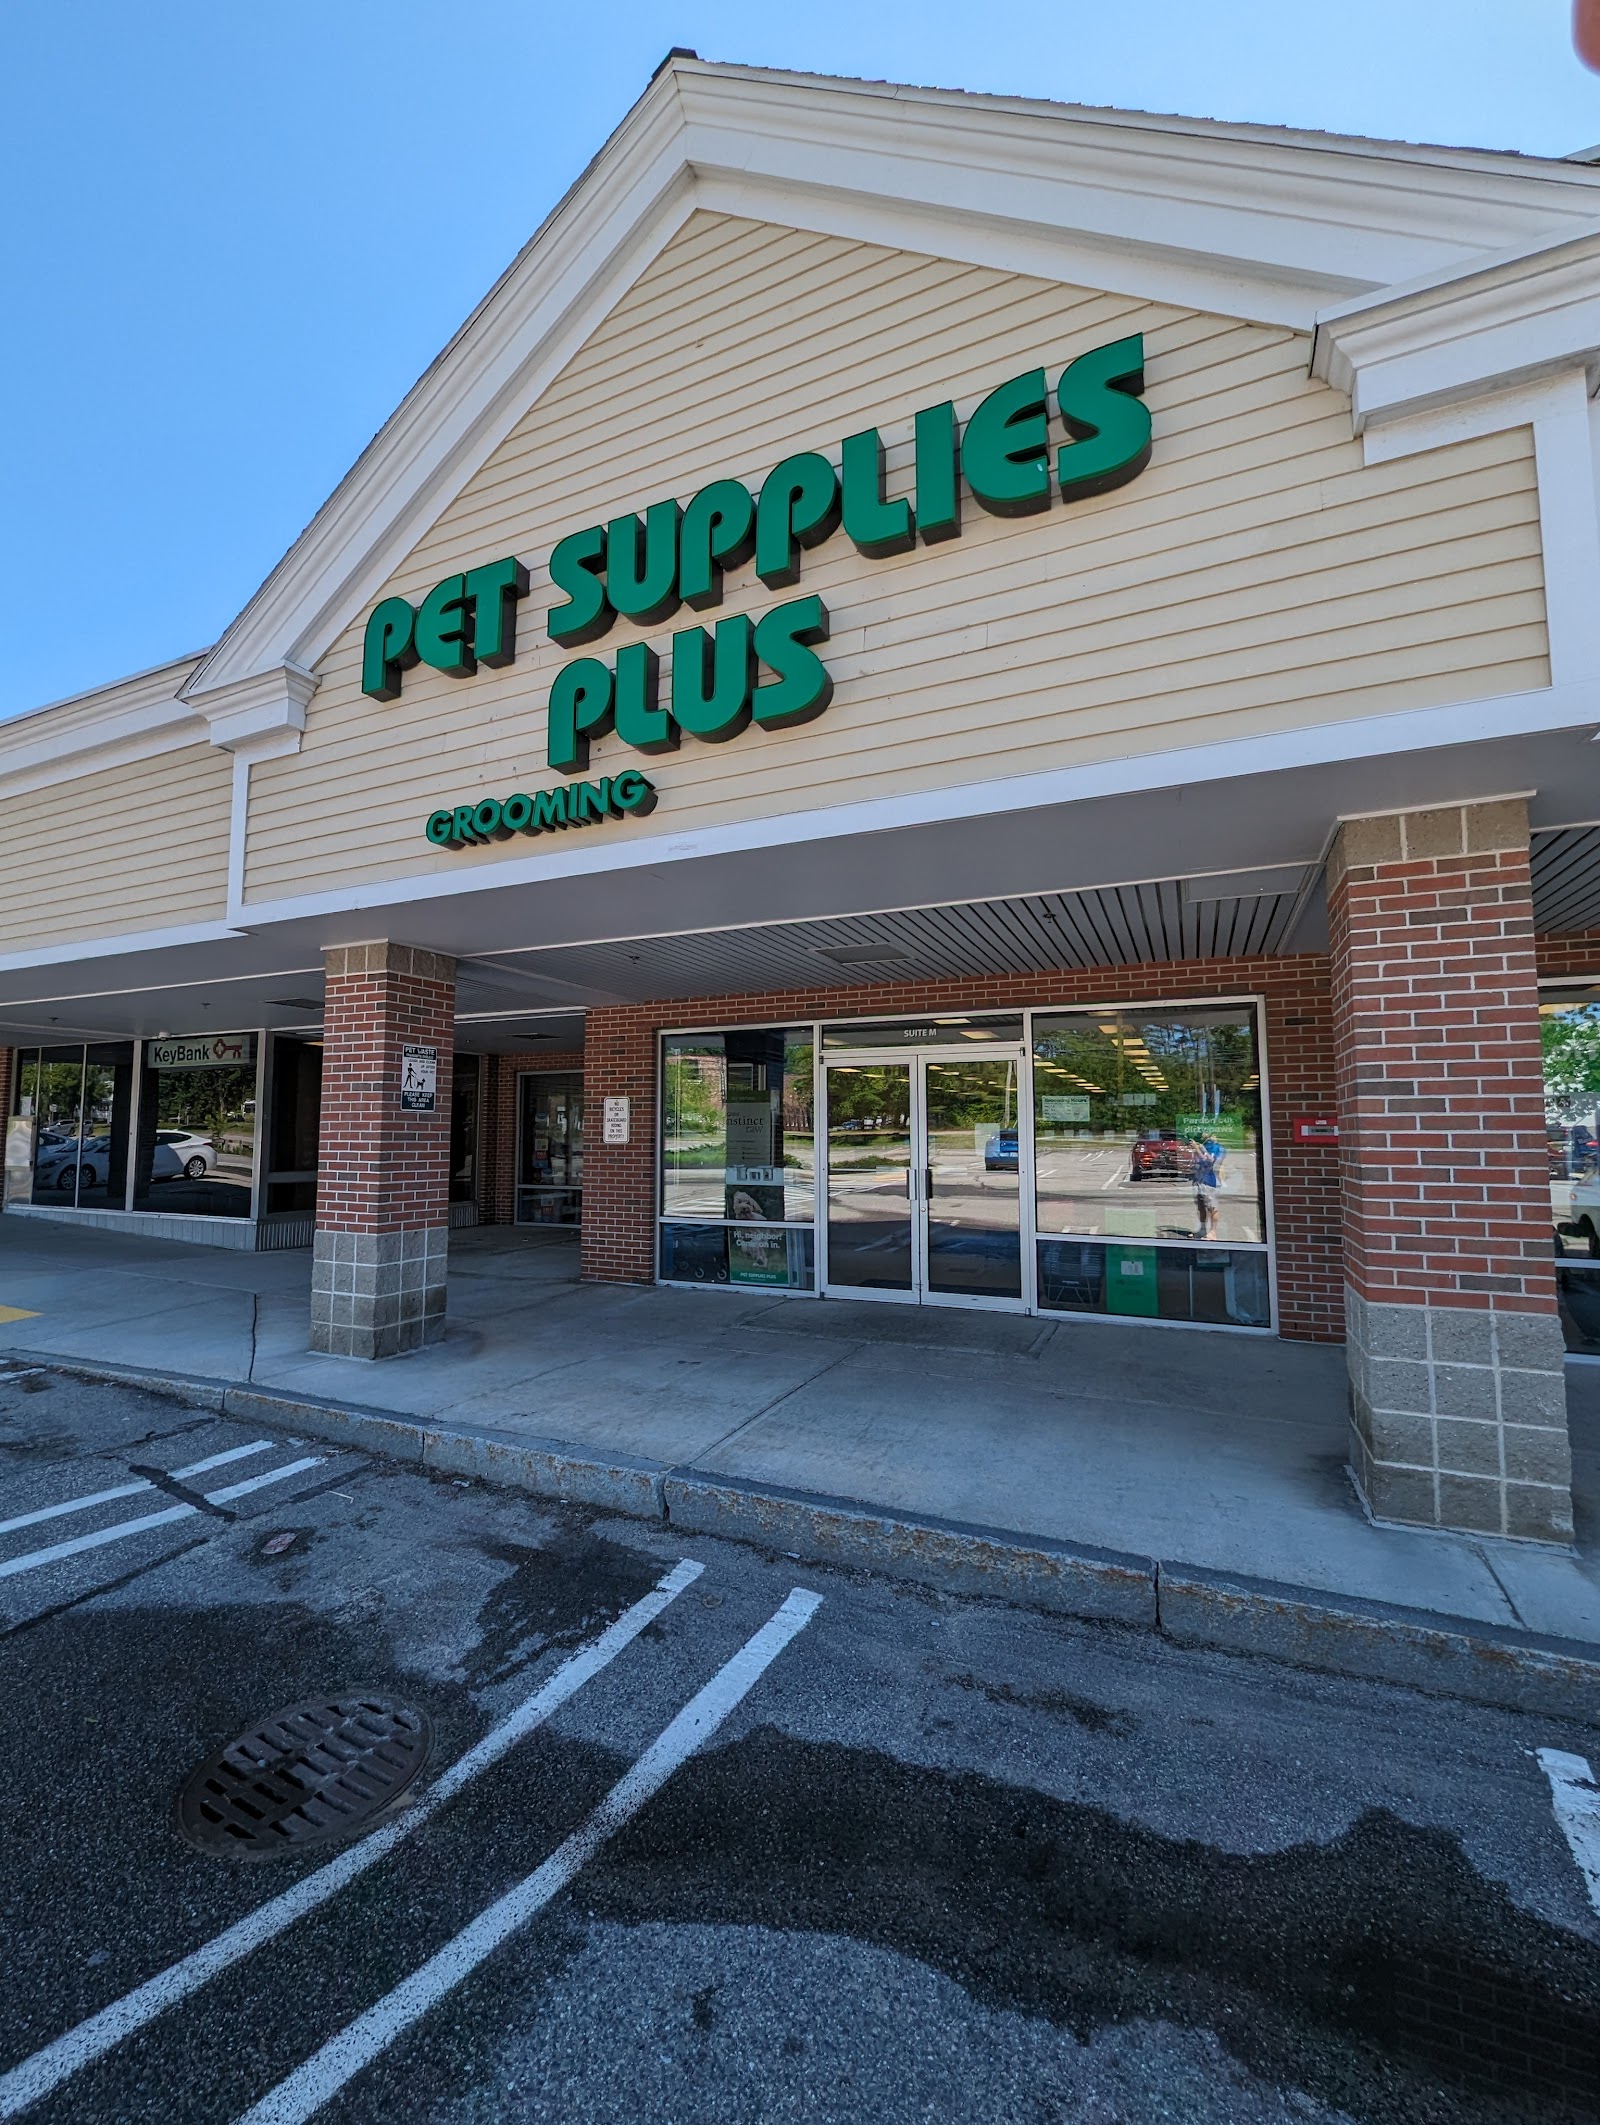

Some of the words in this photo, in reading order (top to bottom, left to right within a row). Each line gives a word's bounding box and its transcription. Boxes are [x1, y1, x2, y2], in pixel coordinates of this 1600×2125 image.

[361, 556, 530, 700] PET
[547, 332, 1153, 647] SUPPLIES
[547, 594, 834, 773] PLUS
[426, 769, 658, 849] GROOMING
[903, 1029, 928, 1038] SUITE
[928, 1028, 937, 1036] M
[153, 1044, 210, 1065] KeyBank
[405, 1046, 416, 1054] PET
[417, 1048, 435, 1056] WASTE
[727, 1115, 763, 1126] nstinct
[733, 1231, 744, 1240] Hi,
[745, 1231, 782, 1241] neighbor!
[770, 1241, 780, 1249] in.
